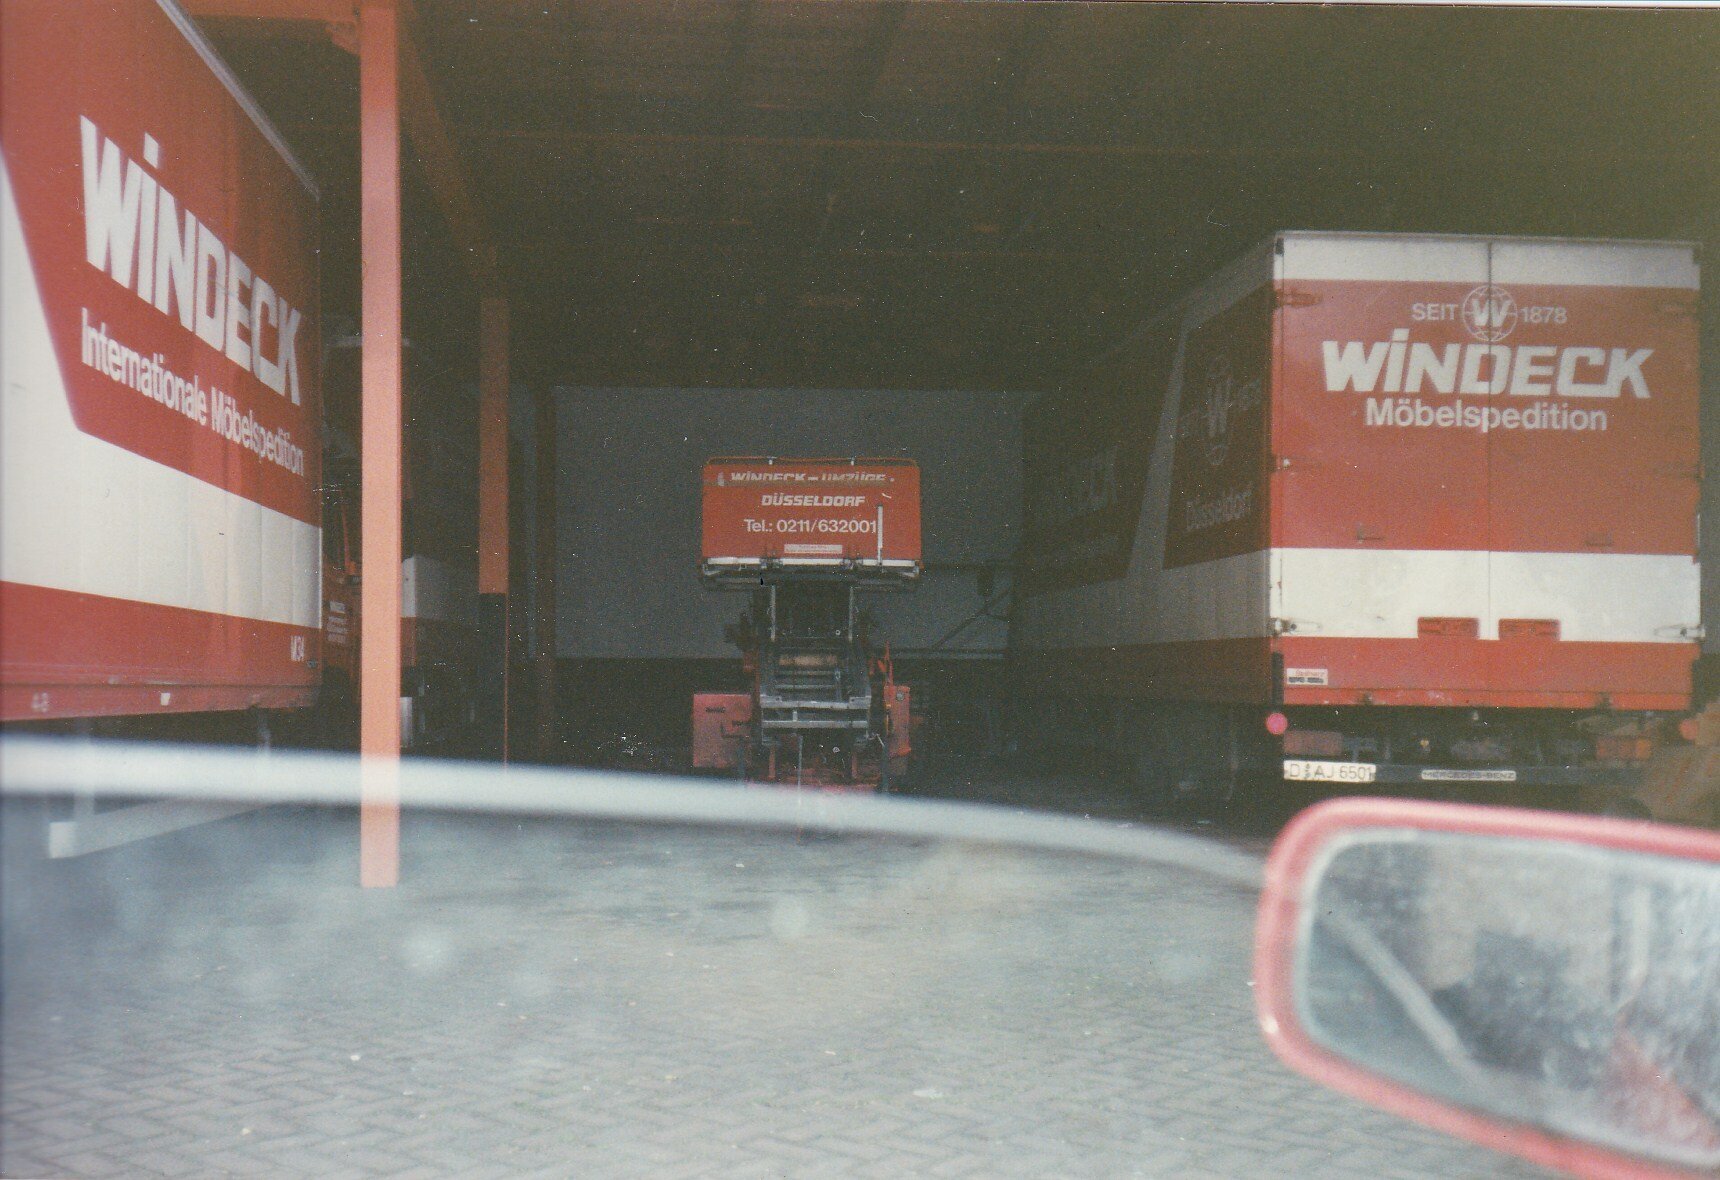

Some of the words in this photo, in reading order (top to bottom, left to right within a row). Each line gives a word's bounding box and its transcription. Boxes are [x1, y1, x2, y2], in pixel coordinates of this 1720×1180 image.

[1411, 303, 1459, 321] SEIT
[1520, 306, 1568, 325] 1878
[81, 307, 207, 427] Internationale
[211, 386, 304, 477] Möbelspedition
[1364, 397, 1608, 433] Möbelspedition
[761, 492, 866, 507] DÜSSELDORF
[743, 519, 773, 533] Tel.:
[776, 519, 877, 533] 0211/632001
